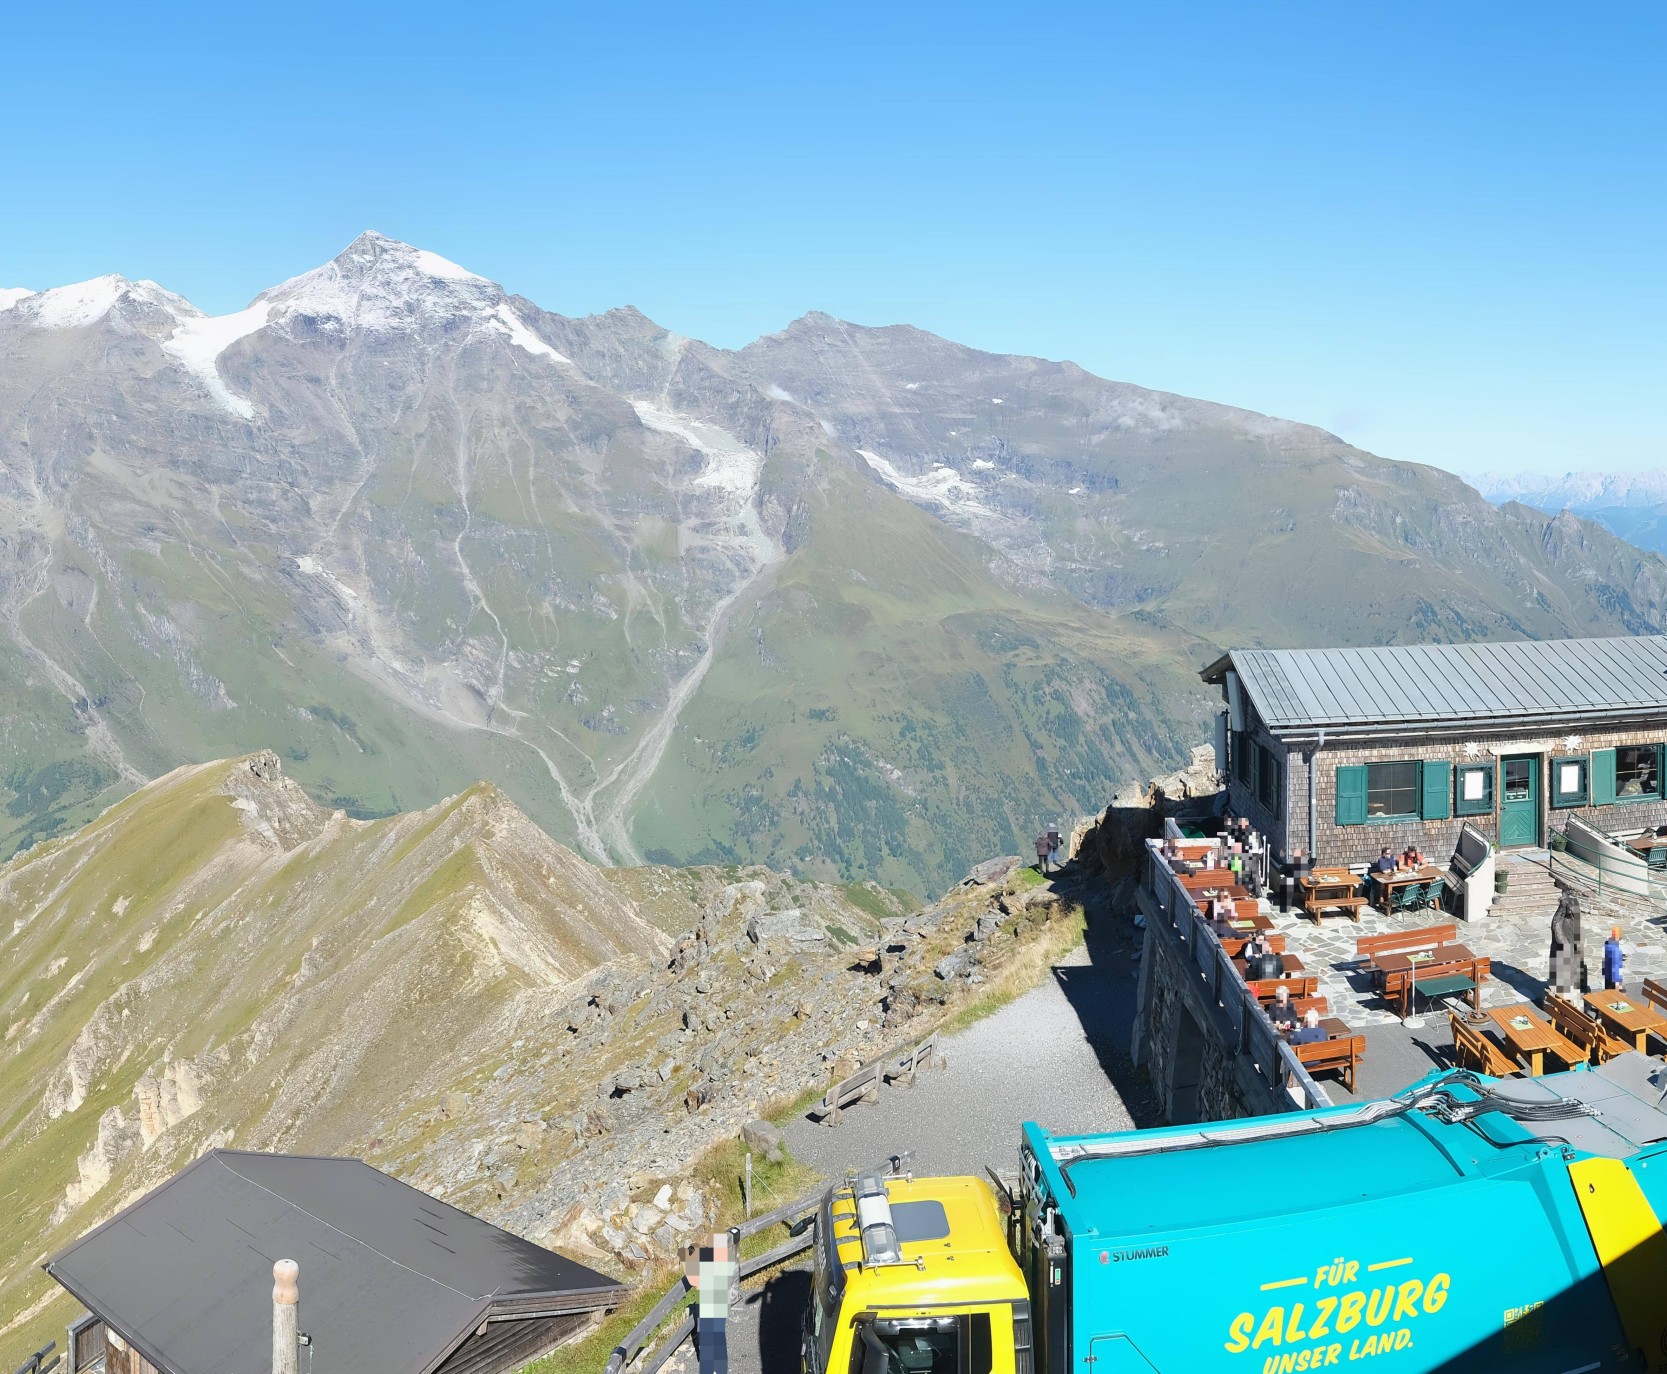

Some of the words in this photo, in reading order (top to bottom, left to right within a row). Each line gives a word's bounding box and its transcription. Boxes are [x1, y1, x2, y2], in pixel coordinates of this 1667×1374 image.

[1112, 1245, 1169, 1263] STUMMER
[1314, 1257, 1360, 1289] FÜR
[1224, 1272, 1451, 1354] SALZBURG
[1262, 1343, 1342, 1374] UNSER
[1349, 1328, 1414, 1361] LAND.
